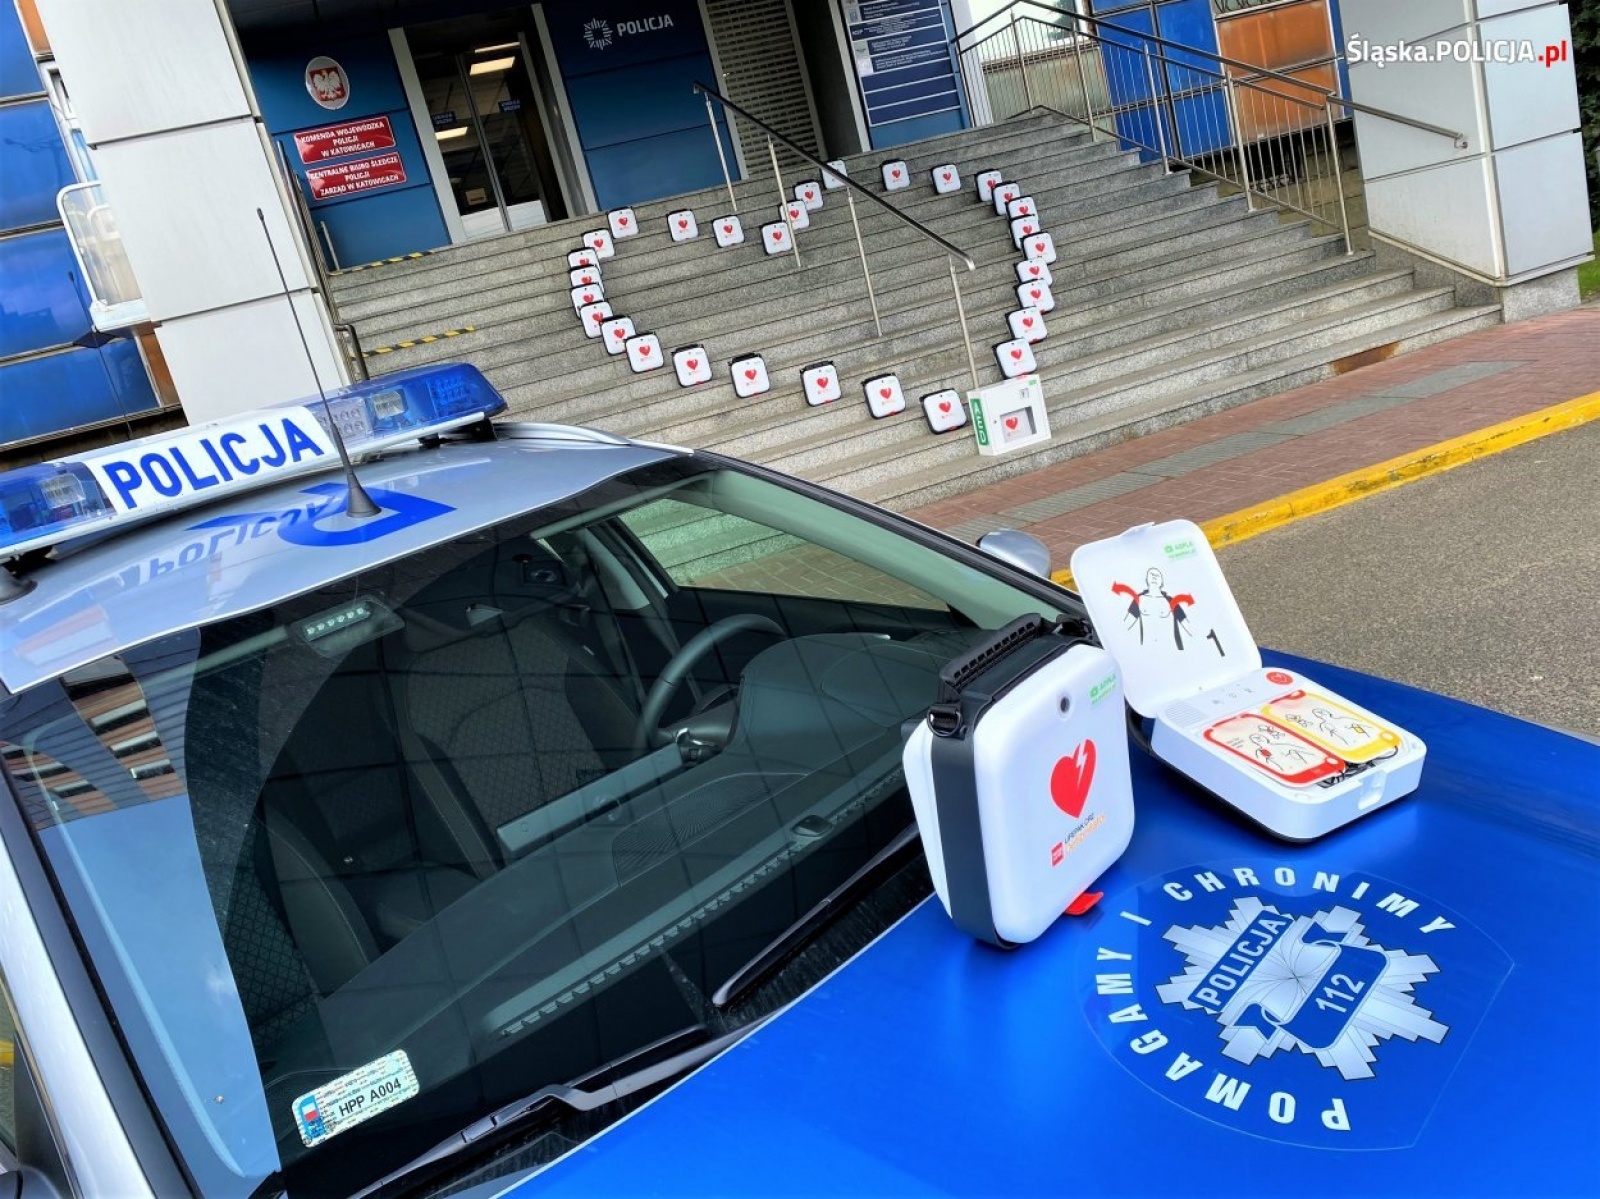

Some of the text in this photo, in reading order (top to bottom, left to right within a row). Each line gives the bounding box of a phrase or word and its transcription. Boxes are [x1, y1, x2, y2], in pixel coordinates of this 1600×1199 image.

[616, 14, 674, 37] POLICJA
[300, 121, 385, 144] KOMENDA WOJEWÓDZKA
[332, 136, 359, 147] POLICJI
[321, 141, 376, 158] W KATOWICACH
[309, 155, 399, 180] CENTRALNE BIURO ŚLEDCZE
[344, 171, 371, 182] POLICJI
[320, 185, 347, 197] ZARZĄD
[355, 174, 400, 188] KATOWICACH
[102, 418, 325, 510] POLICJA
[1206, 628, 1226, 657] 1
[1195, 918, 1287, 1007] POLICJA
[1096, 866, 1456, 1131] POMAGAMY I CHRONIMY
[1315, 974, 1366, 1014] 112
[338, 1094, 366, 1117] HPP
[370, 1077, 402, 1103] A004
